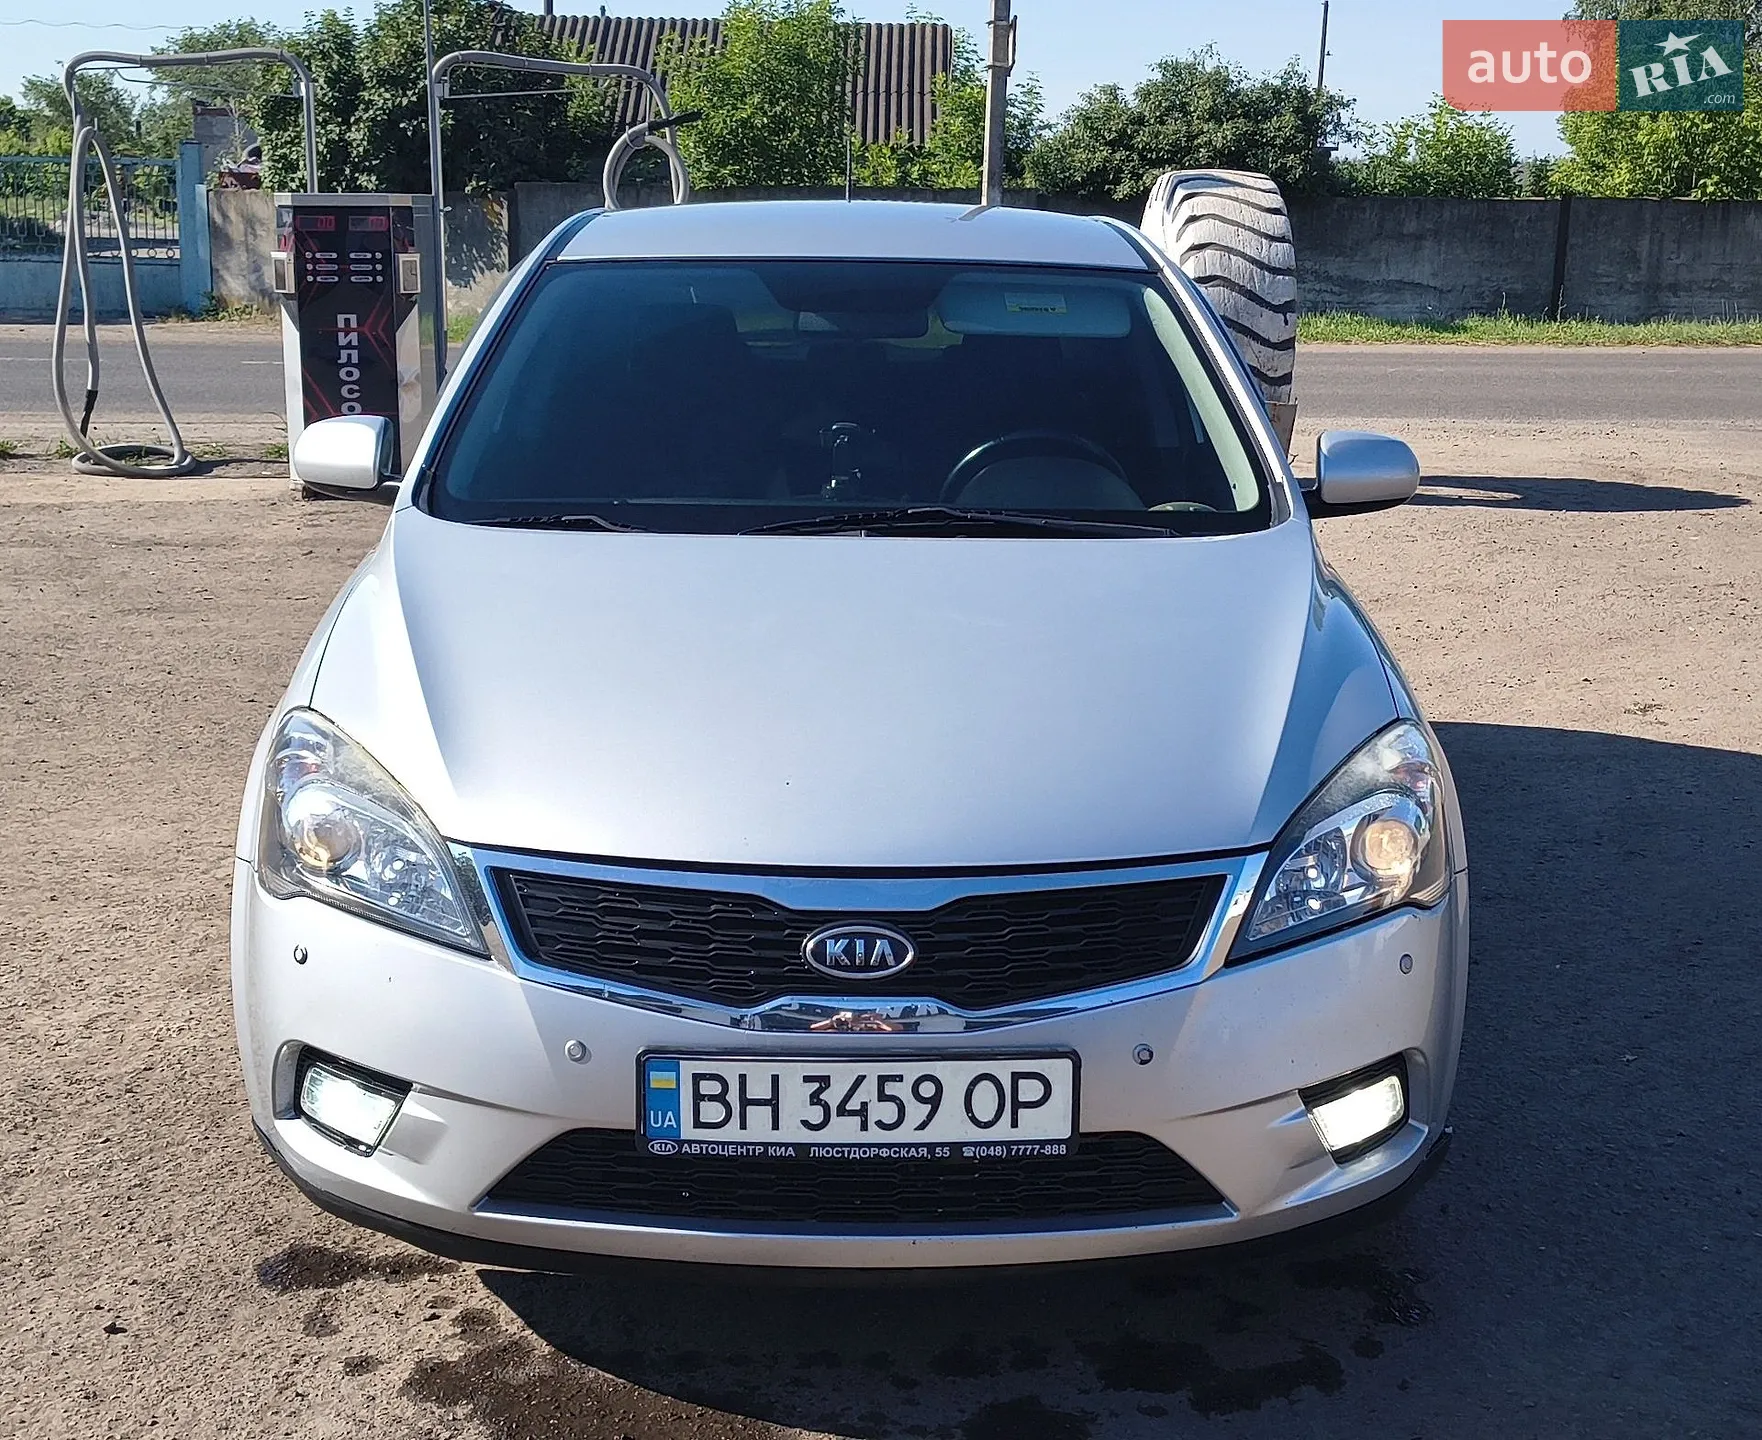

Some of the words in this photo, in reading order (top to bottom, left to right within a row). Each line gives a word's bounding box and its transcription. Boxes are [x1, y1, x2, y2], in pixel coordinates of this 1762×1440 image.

[825, 938, 896, 966] KIA
[691, 1072, 780, 1131] BH
[800, 1073, 943, 1132] 3459
[963, 1071, 1053, 1130] OP
[650, 1110, 677, 1128] UA
[653, 1143, 673, 1153] KIA
[681, 1143, 764, 1157] АВТОЦЕНТР
[768, 1145, 796, 1157] КИА
[809, 1146, 931, 1160] ЛЮСТДОРФСКАЯ,
[935, 1146, 950, 1157] 55
[975, 1144, 1007, 1157] (048)
[1010, 1144, 1067, 1156] 7777-888
